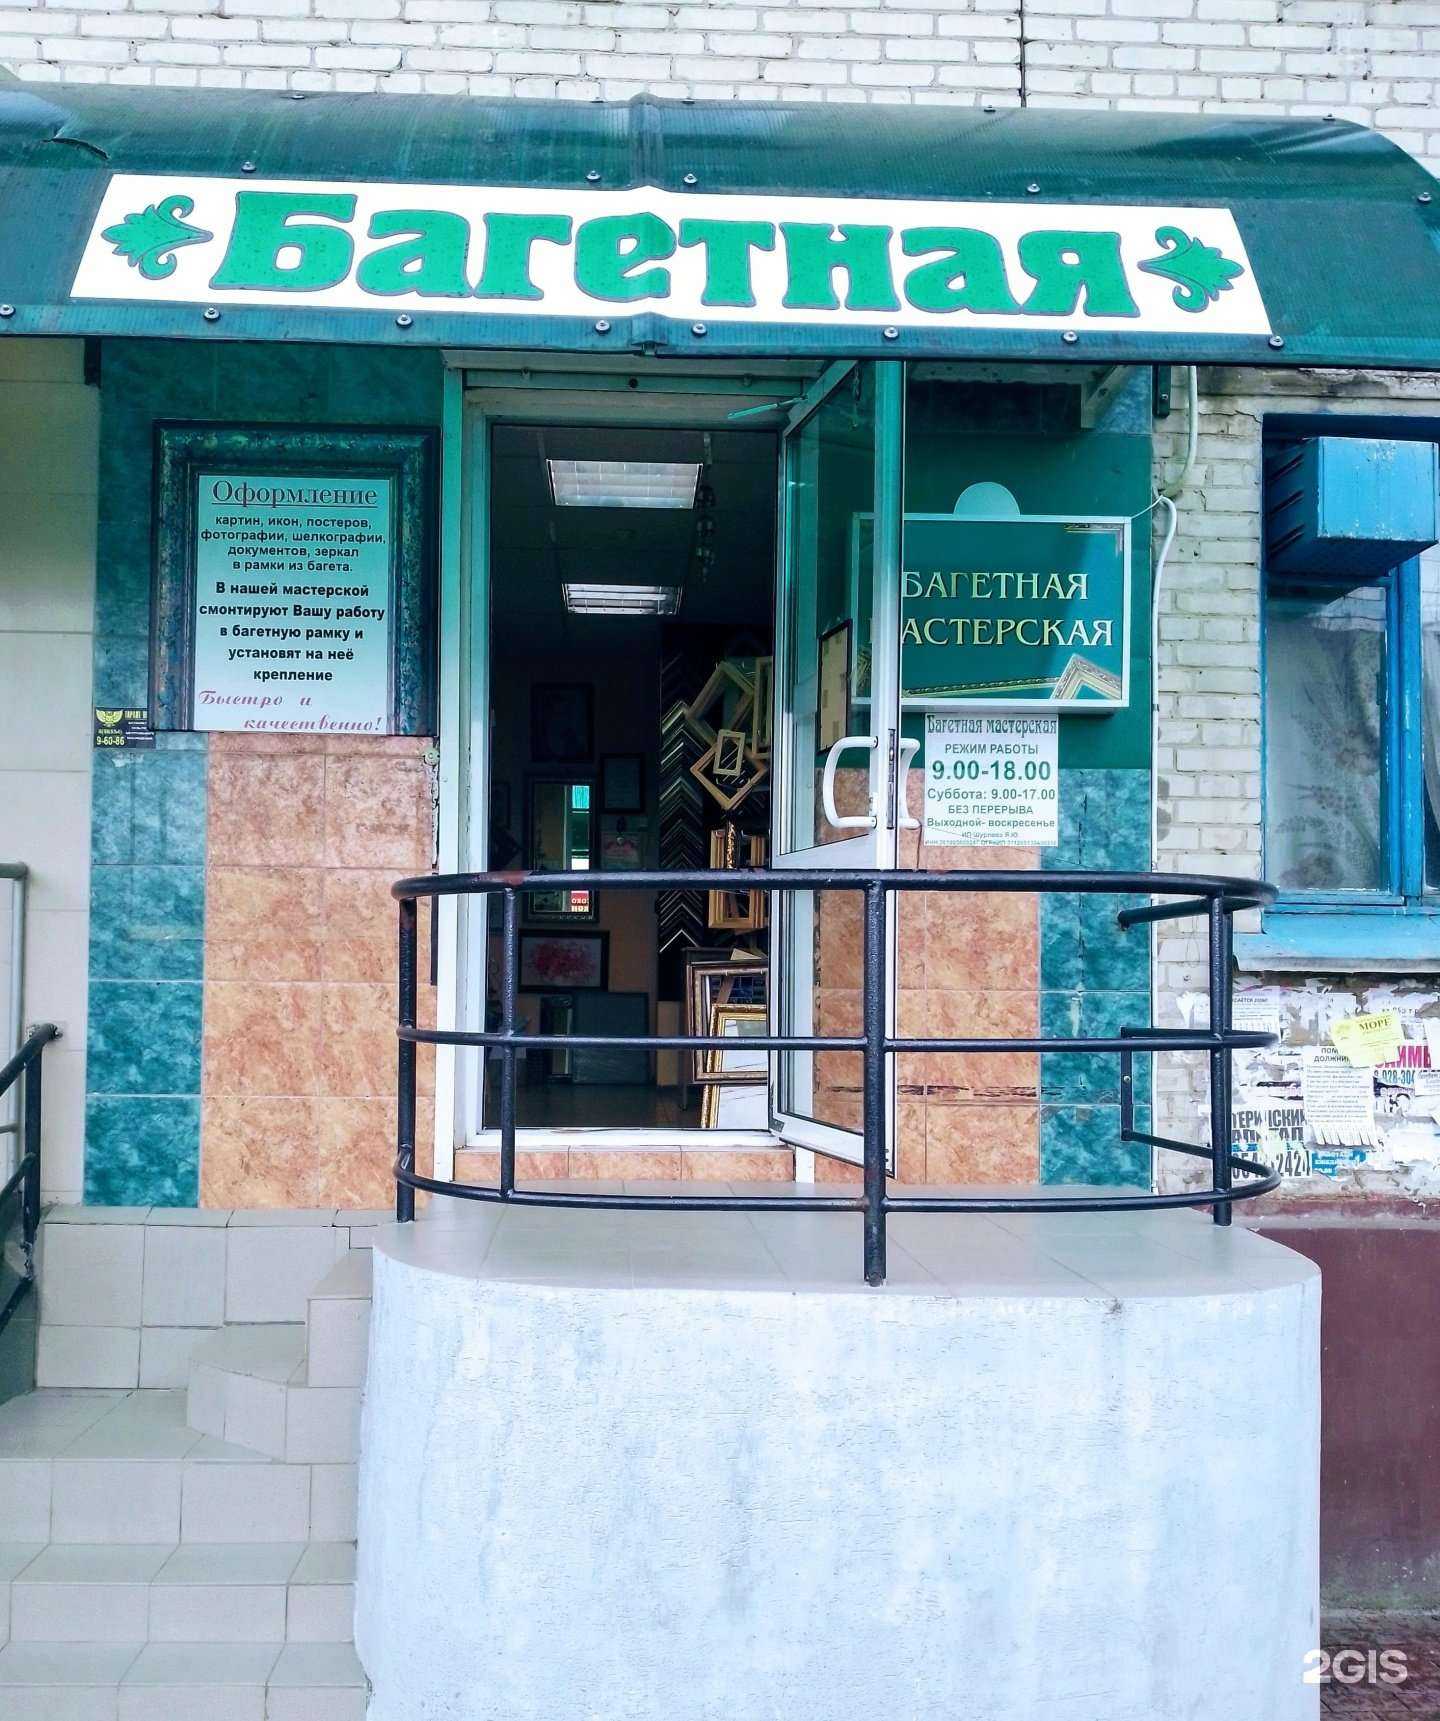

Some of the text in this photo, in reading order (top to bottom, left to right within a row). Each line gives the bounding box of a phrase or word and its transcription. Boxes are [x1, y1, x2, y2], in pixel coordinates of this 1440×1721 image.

[208, 190, 1141, 318] Багетная
[212, 480, 378, 508] Оформление
[215, 516, 372, 530] картин, икон, постеров,
[200, 530, 386, 545] фотографии, шелкографии,
[228, 546, 359, 558] документов, зеркал
[232, 560, 353, 572] в рамки из багета.
[216, 581, 369, 598] В нашей мастерской
[902, 571, 1088, 600] БАГЕТНАЯ
[199, 605, 385, 621] смонтируют Вашу работу
[220, 624, 363, 641] в багетную рамку и
[868, 618, 1113, 646] АСТЕРСКАЯ
[228, 648, 354, 660] установят на неё
[253, 669, 333, 682] крепление
[199, 690, 312, 708] Быстро и
[244, 713, 382, 731] качественно!
[927, 715, 1057, 738] Багетная мастерская
[944, 743, 1039, 755] РЕЖИМ РАБОТЫ
[932, 760, 1051, 780] 9.00-18.00
[927, 788, 1056, 801] Суббота: 9.00-17.00
[948, 805, 1034, 814] БЕЗ ПЕРЕРЫВА
[927, 818, 1055, 829] Выходной- воскресенье
